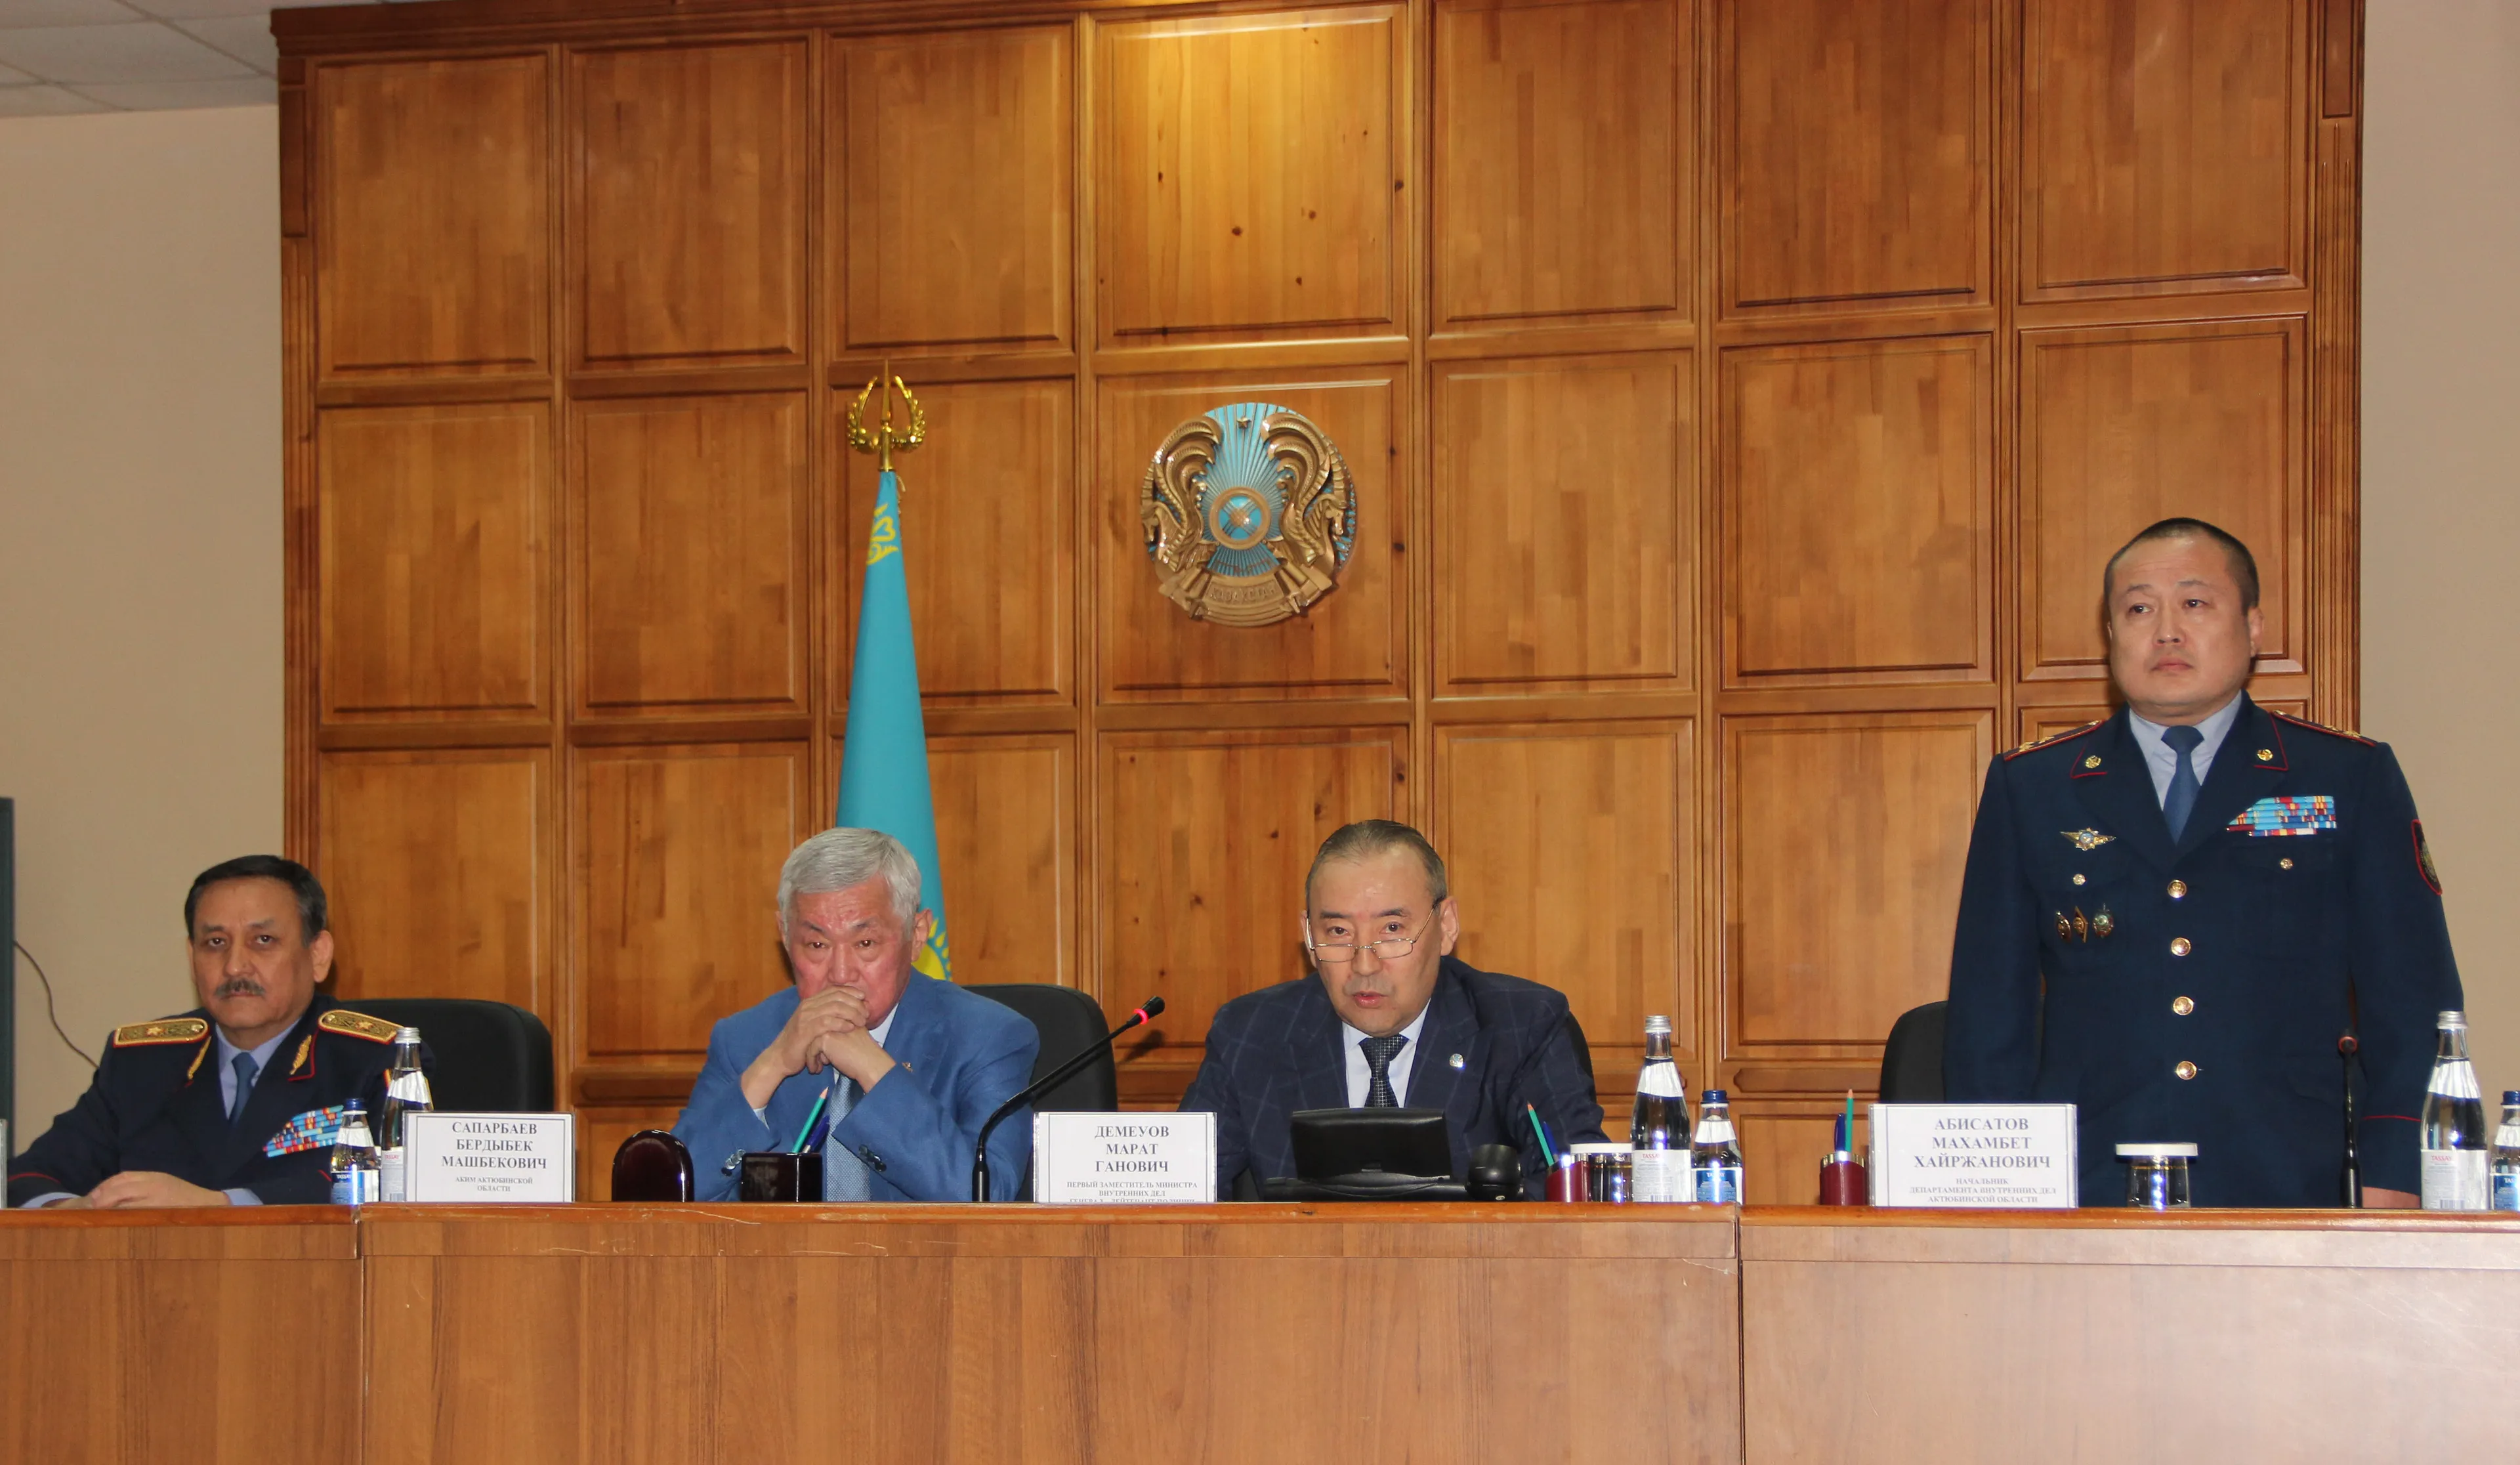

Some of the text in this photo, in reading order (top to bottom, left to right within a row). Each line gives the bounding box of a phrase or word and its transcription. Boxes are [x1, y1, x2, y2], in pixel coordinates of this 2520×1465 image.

[452, 1122, 537, 1135] САПАРБАЕВ
[1935, 1118, 2029, 1130] АБИСАТОВ
[1095, 1126, 1169, 1138] ДЕМЕУОВ
[457, 1139, 533, 1152] БЕРДЫБЕК
[1106, 1143, 1159, 1155] МАРАТ
[1932, 1137, 2032, 1149] МАХАМБЕТ
[442, 1155, 547, 1169] МАШБЕКОВИЧ
[1095, 1161, 1169, 1172] ГАНОВИЧ
[1913, 1153, 2051, 1168] ХАЙРЖАНОВИЧ
